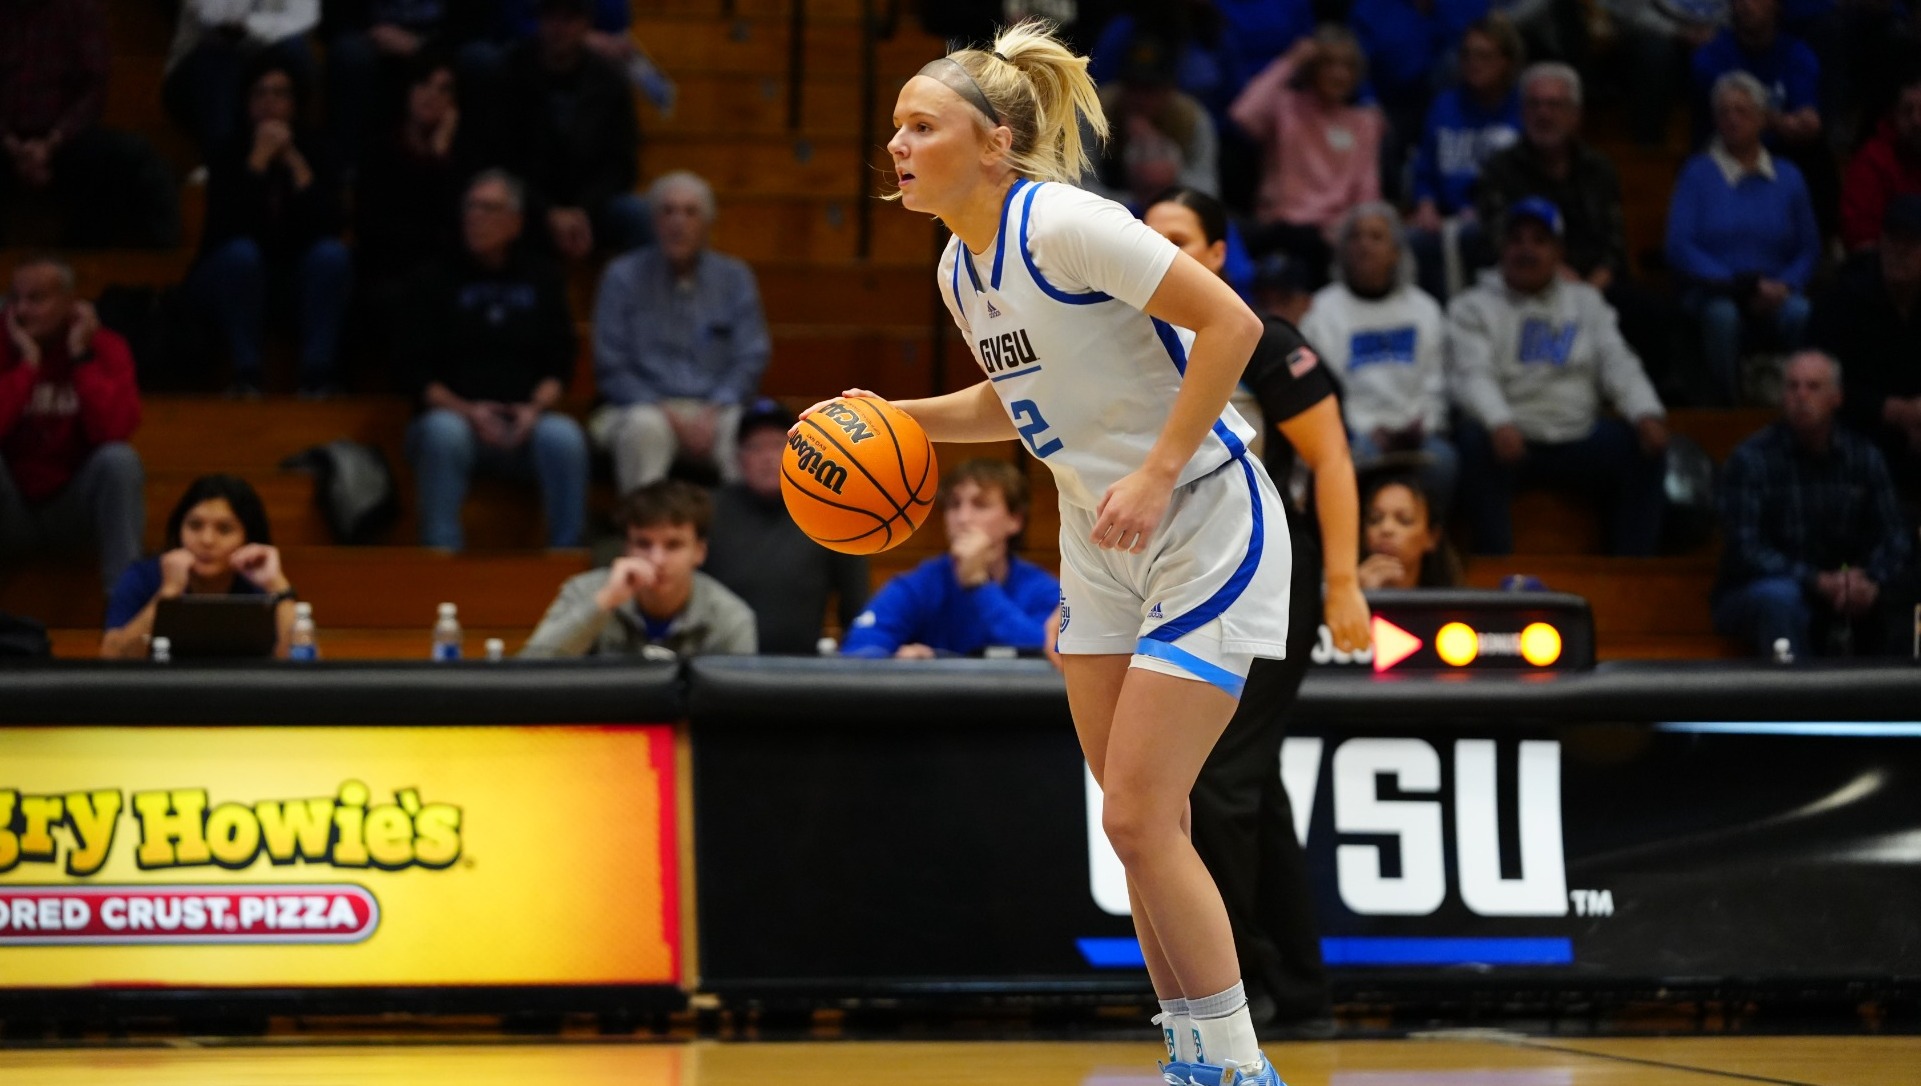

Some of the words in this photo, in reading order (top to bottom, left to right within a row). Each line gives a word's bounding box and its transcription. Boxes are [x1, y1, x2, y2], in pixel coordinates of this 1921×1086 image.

[979, 329, 1037, 373] GVSU
[1010, 399, 1064, 458] 2
[133, 779, 462, 871] Howie's
[100, 897, 230, 930] CRUST
[240, 896, 359, 930] PIZZA
[1570, 890, 1614, 917] TM
